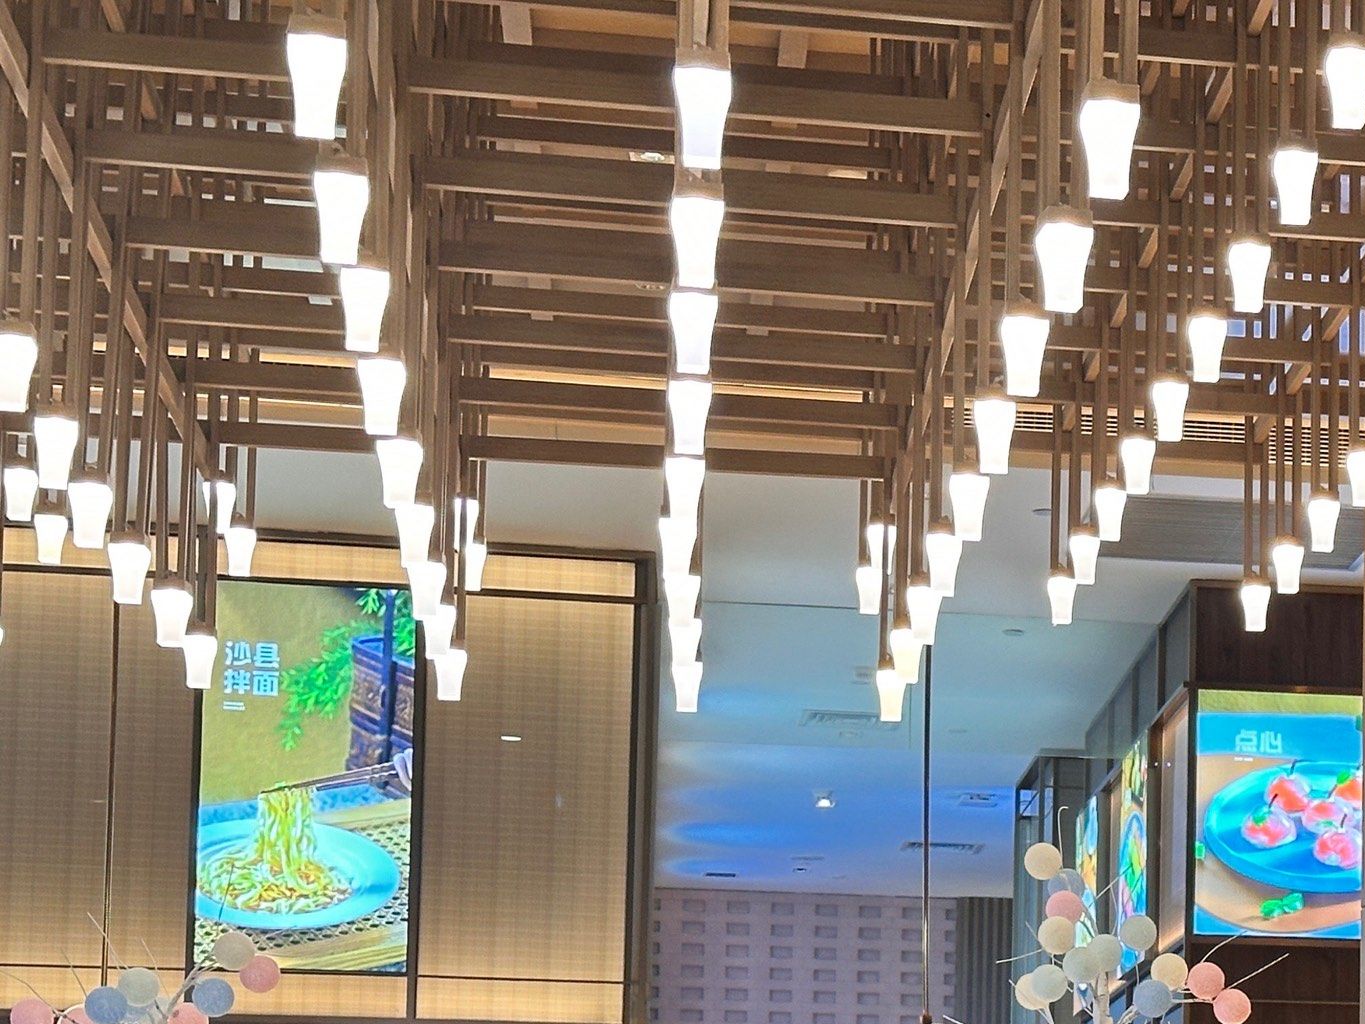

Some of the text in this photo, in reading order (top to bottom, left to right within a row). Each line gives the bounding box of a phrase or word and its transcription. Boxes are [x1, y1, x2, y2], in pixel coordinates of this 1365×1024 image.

[224, 640, 280, 668] 沙县
[223, 668, 280, 696] 拌面
[1234, 728, 1283, 754] 点心
